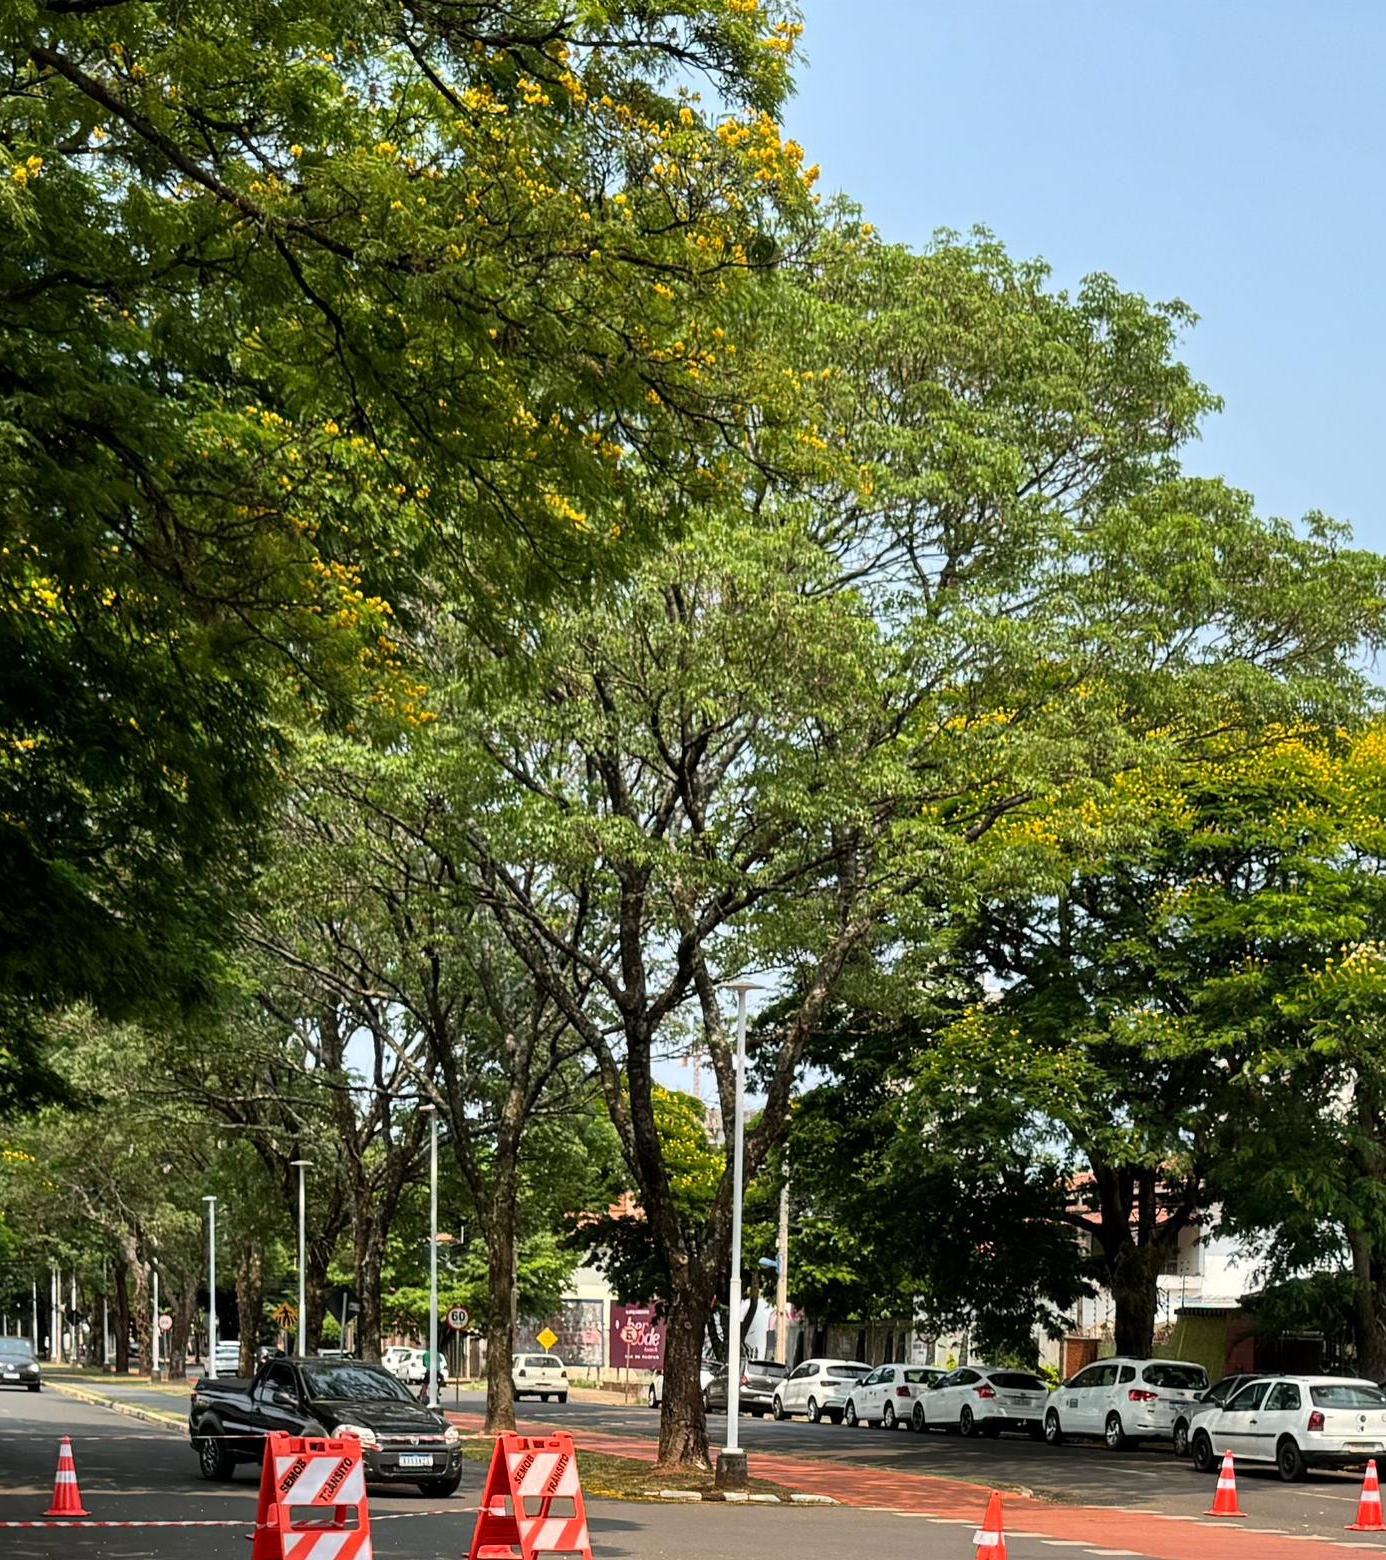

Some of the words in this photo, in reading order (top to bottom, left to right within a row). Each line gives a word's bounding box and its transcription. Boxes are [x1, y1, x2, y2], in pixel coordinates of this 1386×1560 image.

[451, 1310, 465, 1322] 60
[280, 1458, 307, 1494] SEMOB
[513, 1454, 535, 1485] SEMOB
